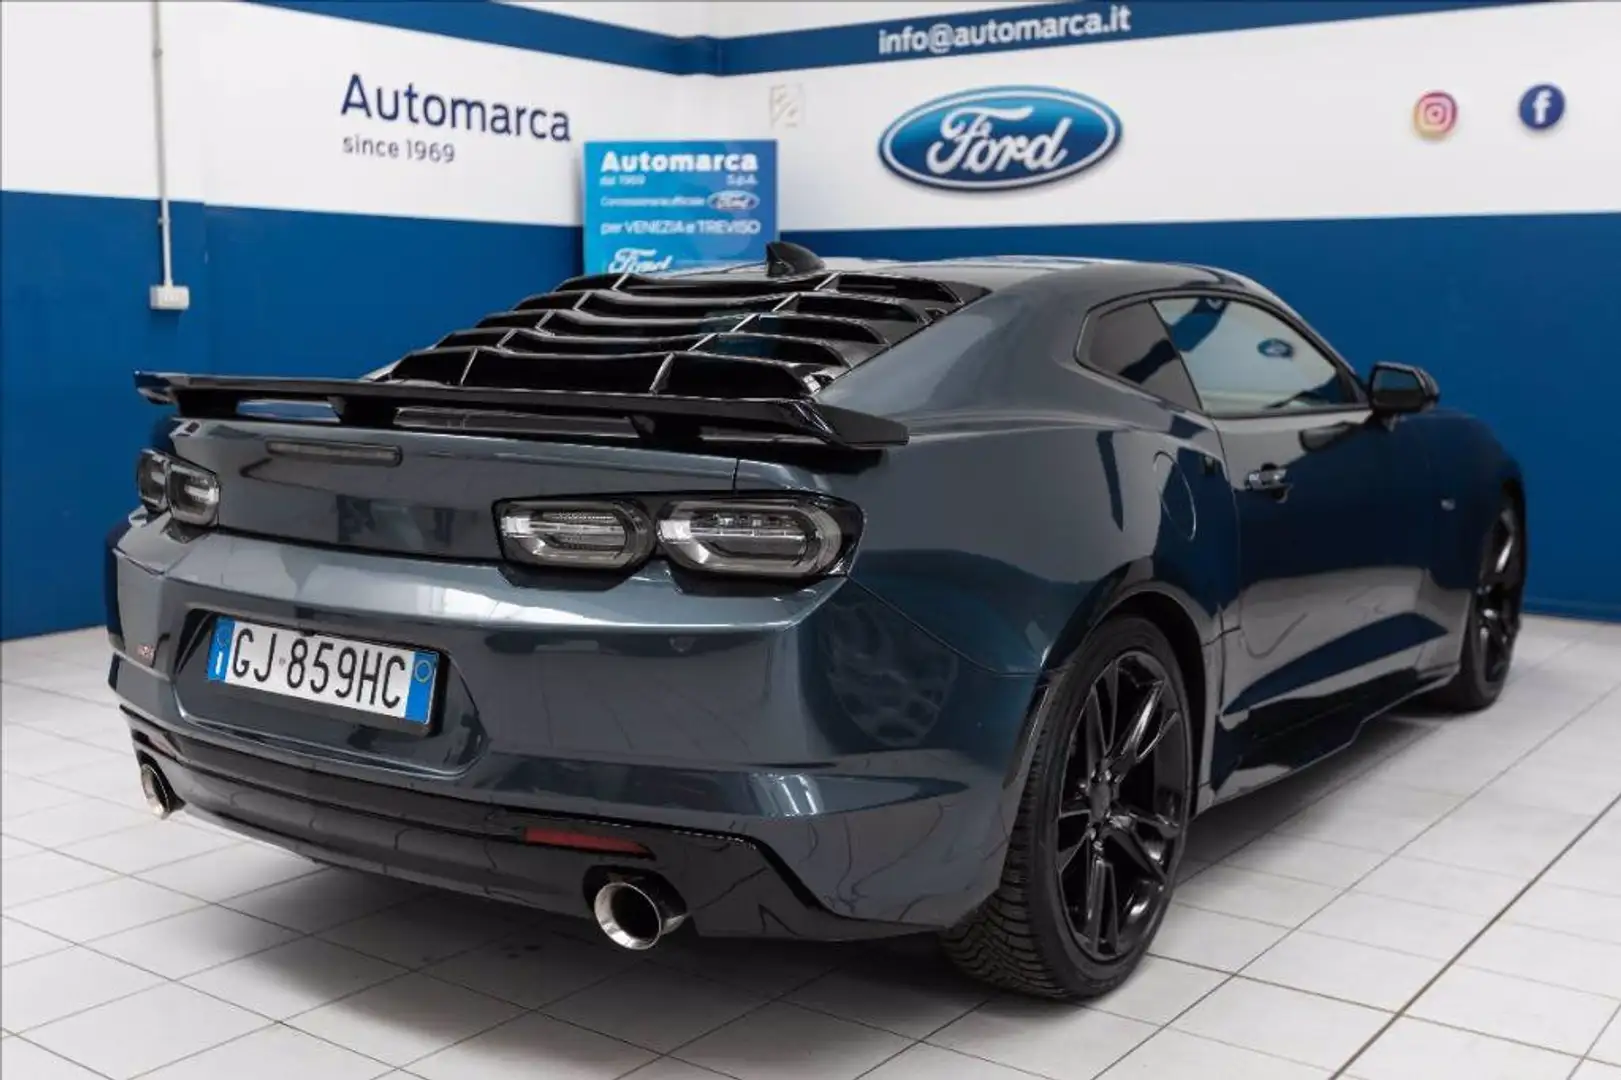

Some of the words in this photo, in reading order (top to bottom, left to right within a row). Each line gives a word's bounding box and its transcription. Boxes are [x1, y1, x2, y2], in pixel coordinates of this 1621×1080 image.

[878, 5, 1131, 54] info@automarca.it
[341, 73, 570, 141] Automarca
[343, 134, 399, 158] since
[406, 139, 455, 163] 1969
[926, 105, 1072, 174] Ford
[601, 151, 758, 172] Automarca
[624, 220, 684, 234] VENEZIA
[697, 219, 762, 235] TREVISO
[608, 247, 673, 273] Ford
